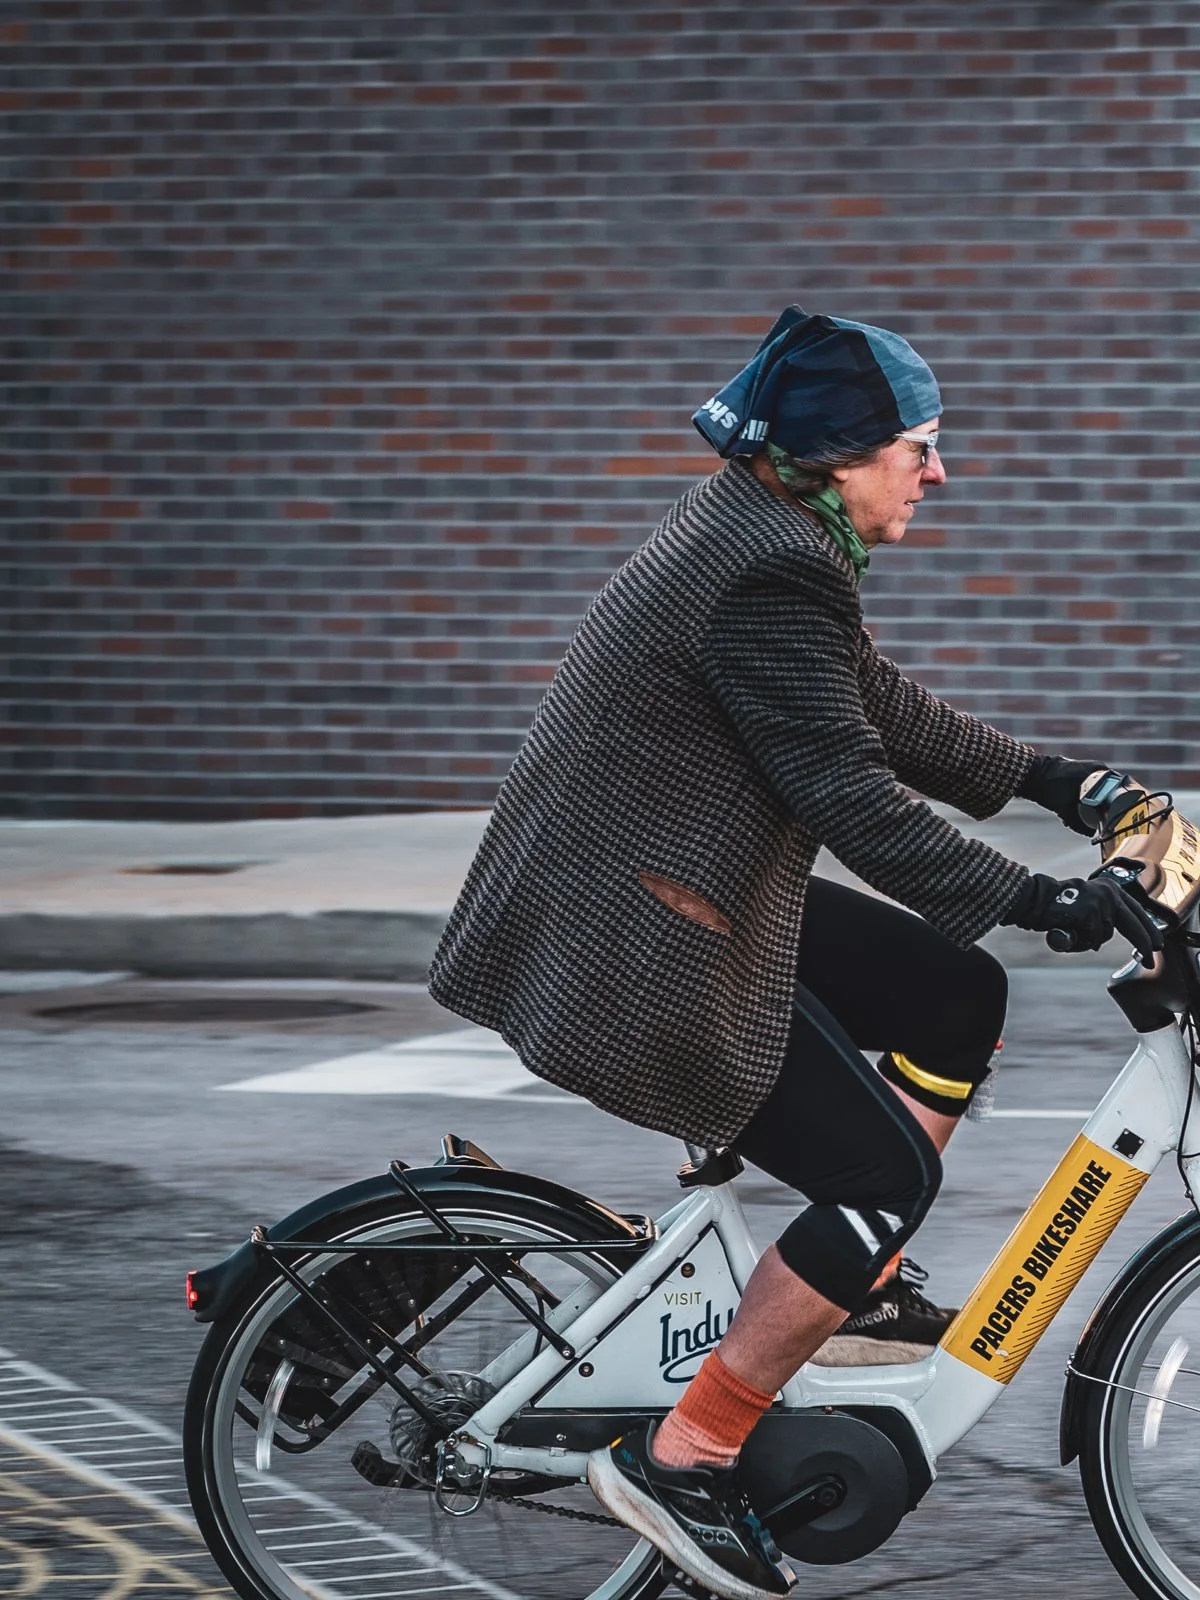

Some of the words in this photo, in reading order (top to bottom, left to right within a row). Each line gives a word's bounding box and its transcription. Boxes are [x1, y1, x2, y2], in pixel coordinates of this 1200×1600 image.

[970, 1275, 1036, 1361] PACERS
[1022, 1160, 1112, 1281] BIKESHARE
[664, 1292, 702, 1306] VISIT
[843, 1301, 899, 1331] aucony
